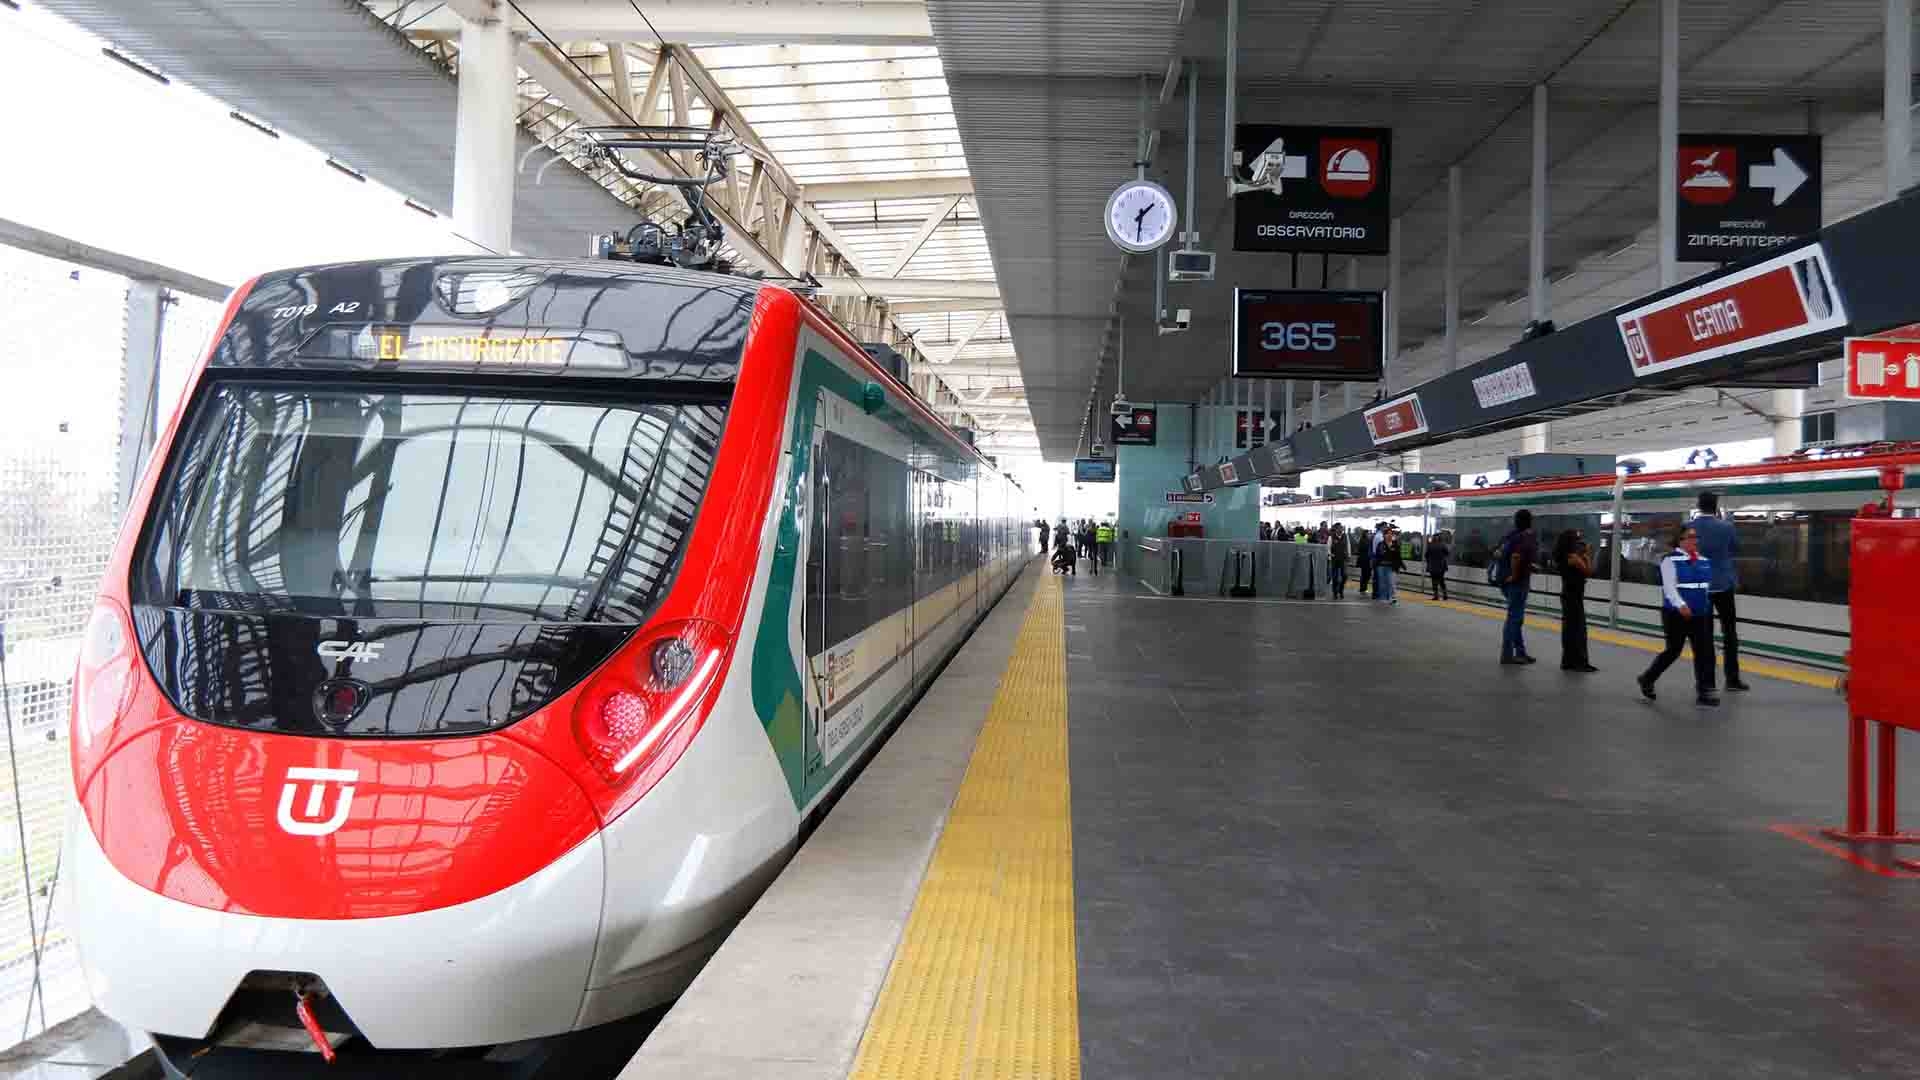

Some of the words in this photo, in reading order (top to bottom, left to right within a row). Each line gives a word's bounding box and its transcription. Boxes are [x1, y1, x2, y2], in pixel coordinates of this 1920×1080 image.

[1256, 224, 1366, 239] OBSERVATORIO
[273, 303, 318, 319] T019
[328, 302, 361, 314] A2
[1686, 299, 1742, 341] LERMA
[379, 335, 408, 360] EL
[421, 334, 565, 362] INSURGENTE
[1261, 321, 1337, 351] 365
[317, 640, 385, 663] CAF
